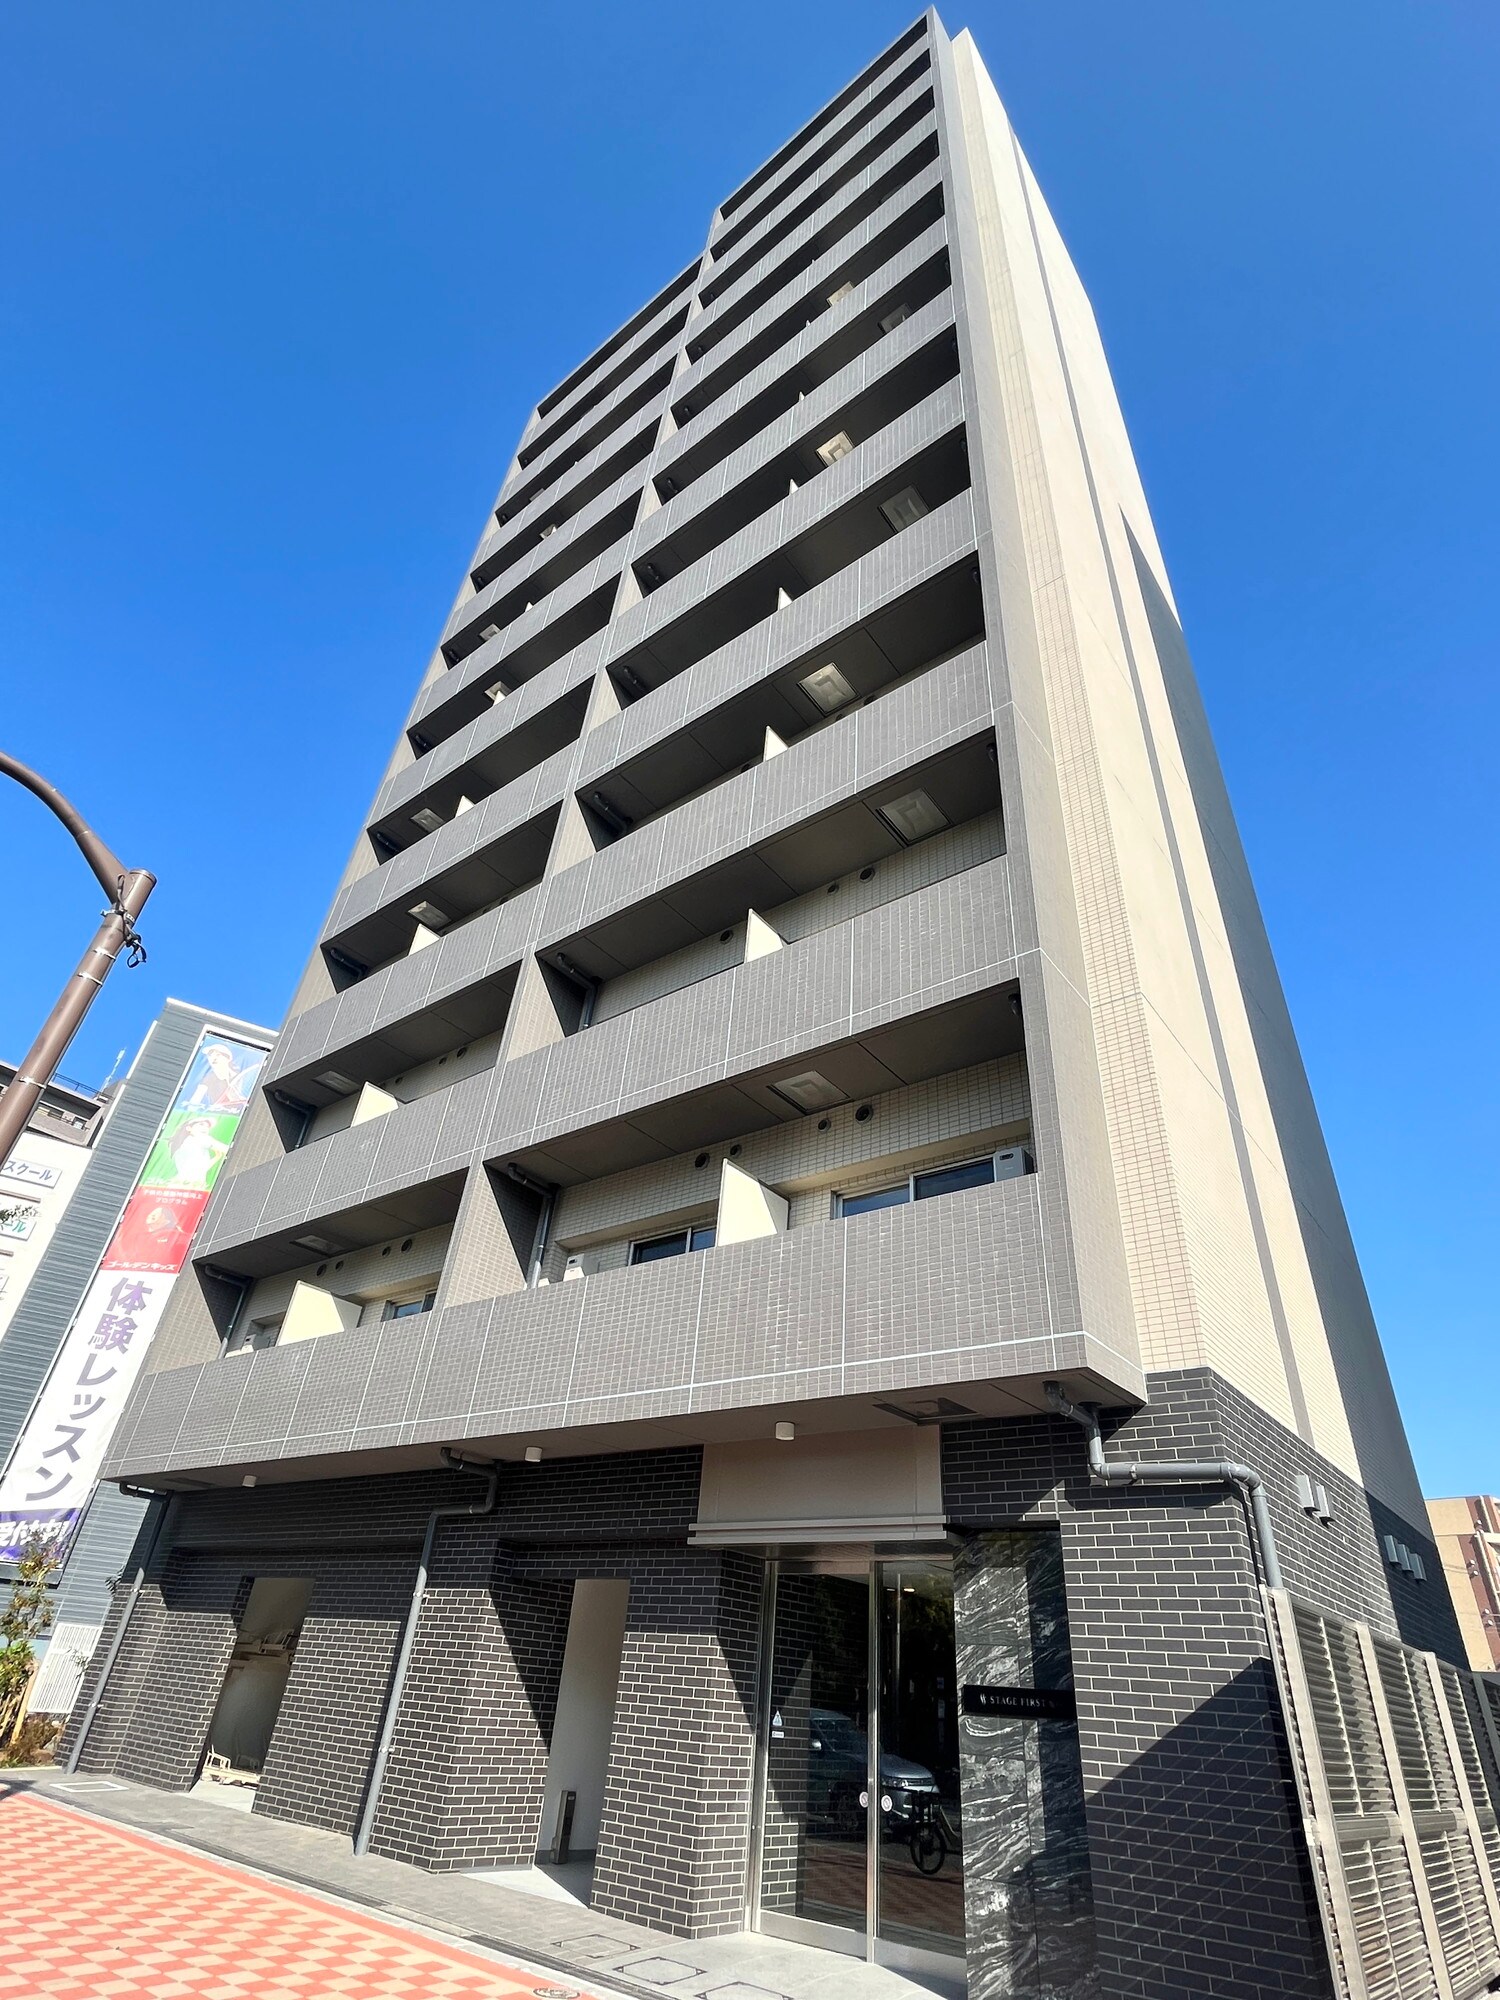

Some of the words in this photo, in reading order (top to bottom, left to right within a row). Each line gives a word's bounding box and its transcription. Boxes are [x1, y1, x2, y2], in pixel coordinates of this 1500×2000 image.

[106, 1261, 178, 1271] ゴールデンキッズ
[25, 1277, 153, 1502] 体験レッスン
[989, 1695, 1018, 1706] STAGE
[1020, 1697, 1046, 1708] FIRST
